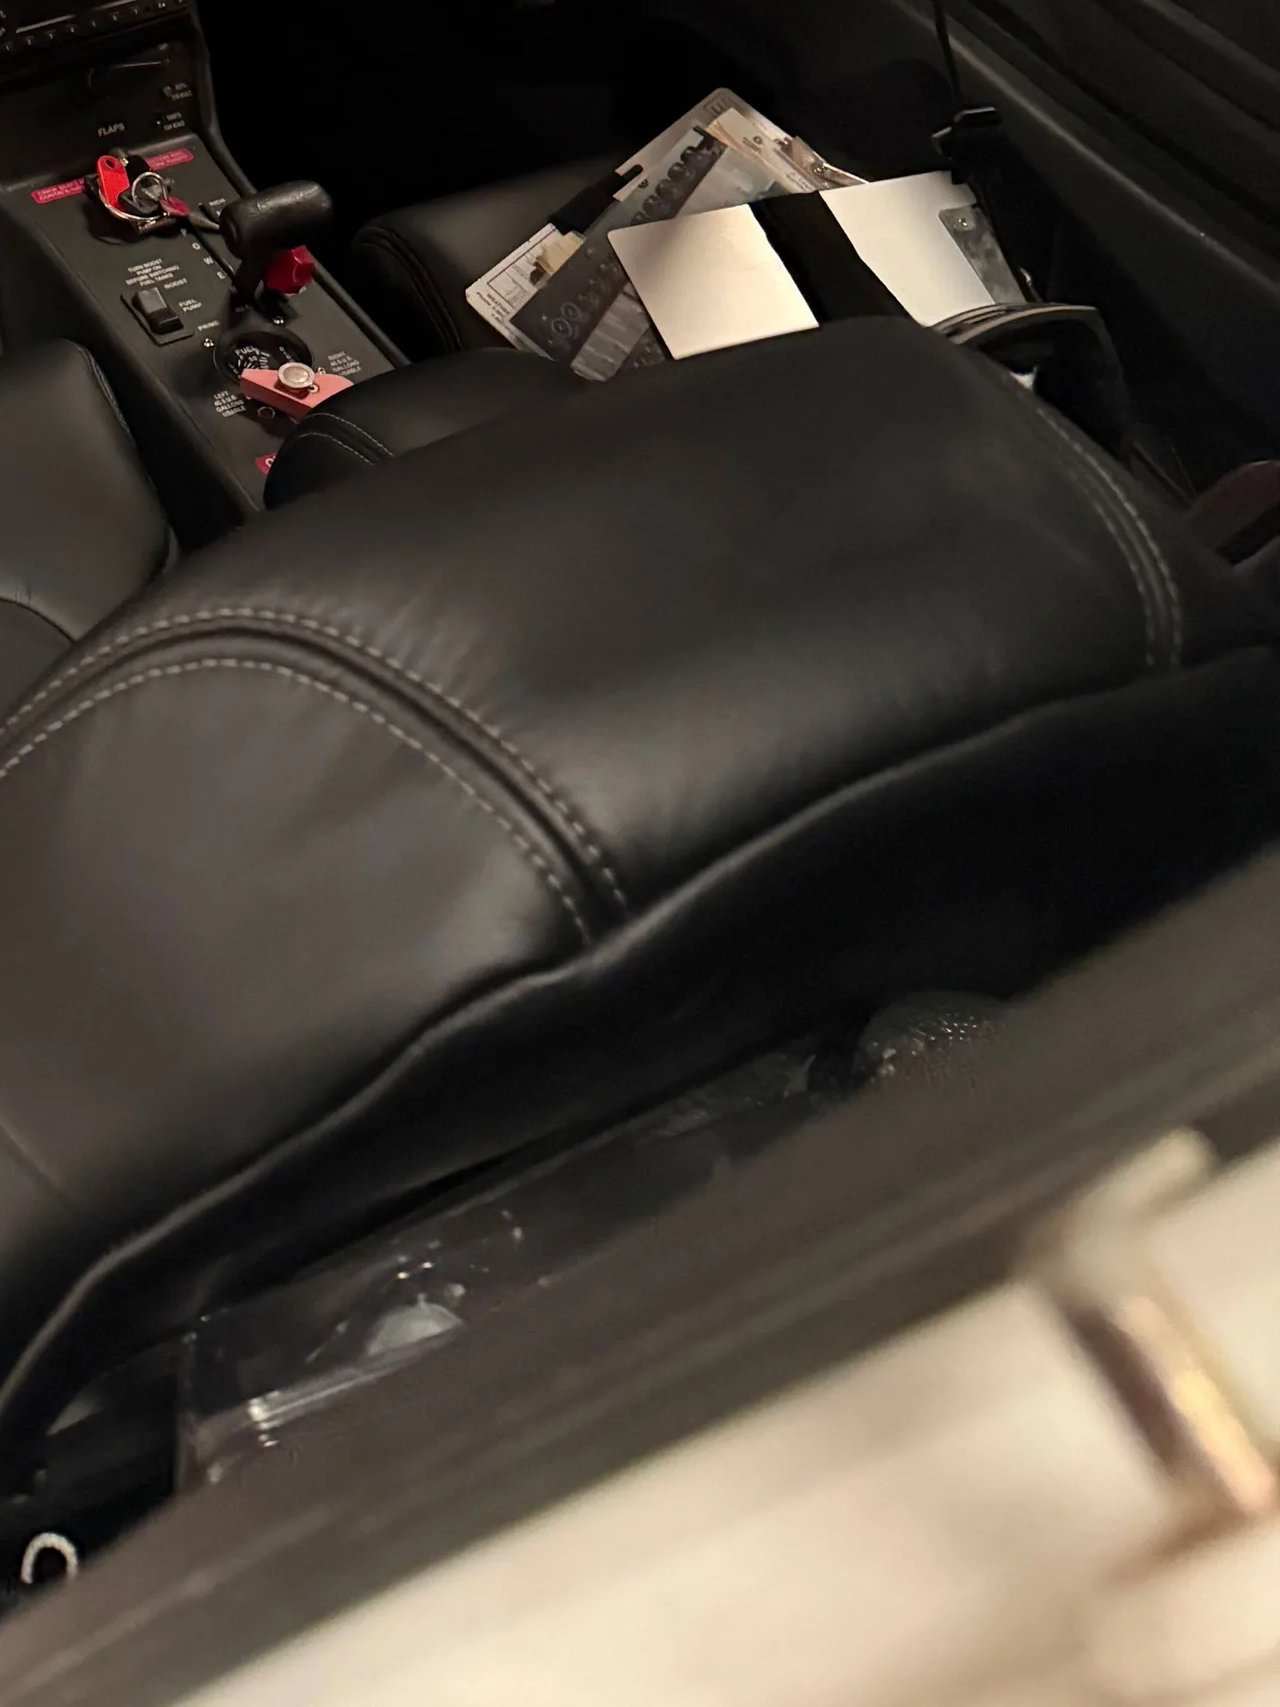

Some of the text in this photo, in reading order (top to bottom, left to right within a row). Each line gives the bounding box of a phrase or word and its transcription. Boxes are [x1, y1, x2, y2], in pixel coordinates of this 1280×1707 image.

[97, 122, 125, 137] FLAPS
[164, 277, 188, 289] BOOST
[178, 298, 198, 307] FUEL
[183, 302, 202, 312] PUMP
[213, 390, 229, 400] LEFT
[215, 399, 244, 413] GALLONS
